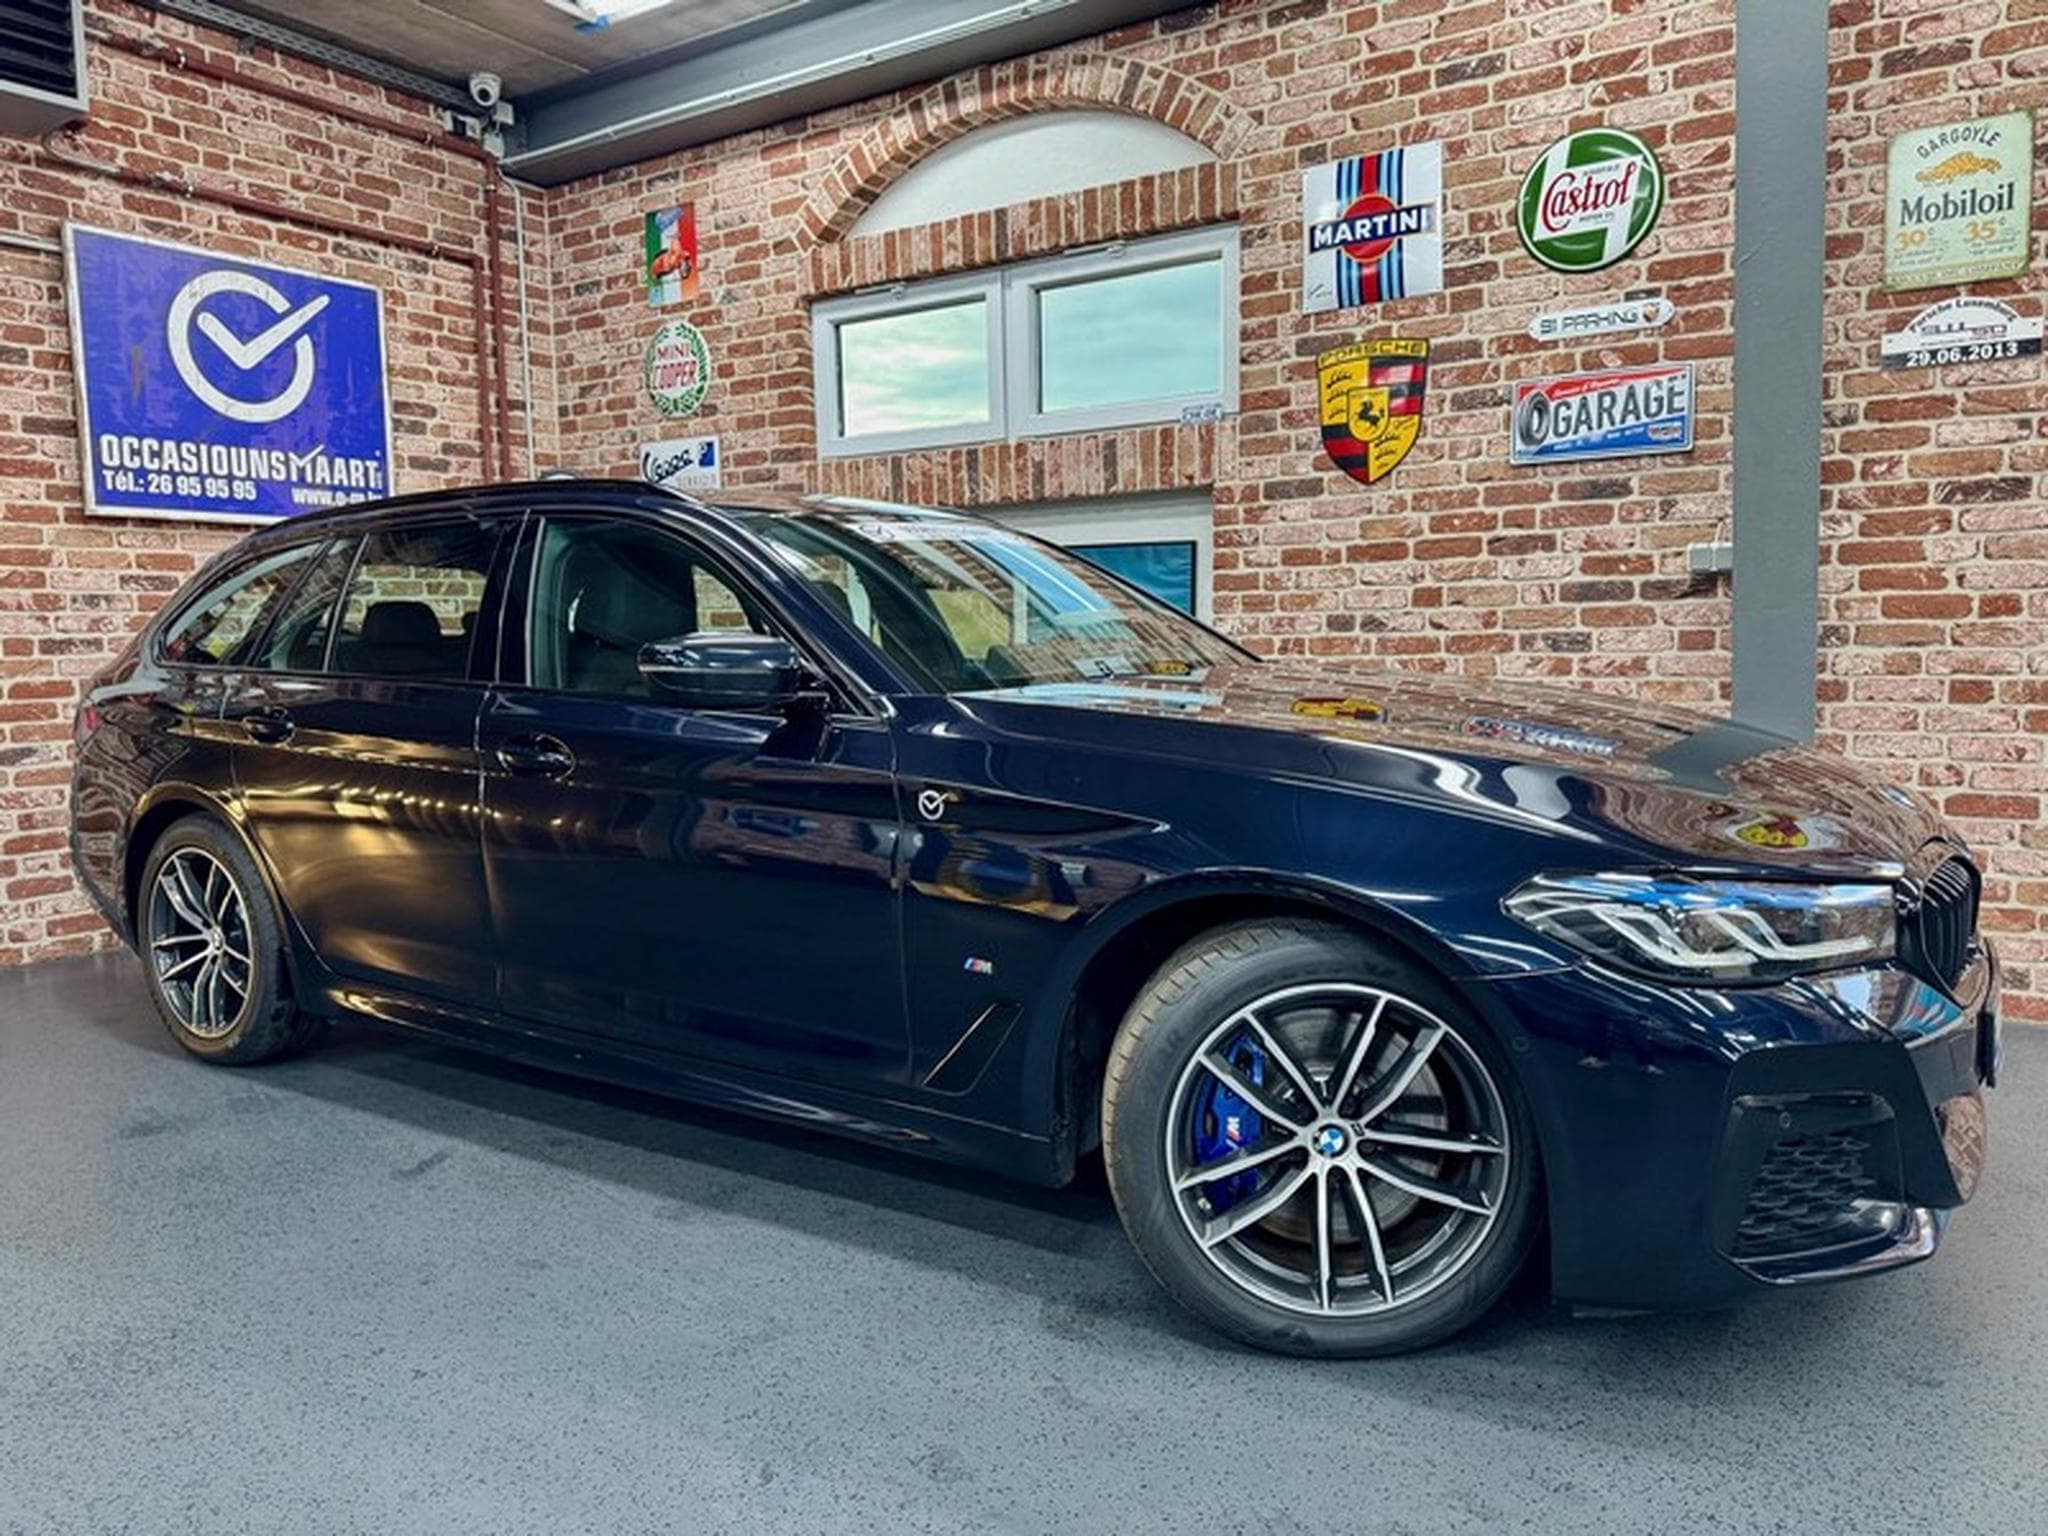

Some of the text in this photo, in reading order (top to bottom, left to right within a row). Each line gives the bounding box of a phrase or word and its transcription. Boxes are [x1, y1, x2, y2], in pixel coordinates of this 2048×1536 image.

[1916, 126, 2001, 159] GARGOYLE
[1542, 161, 1636, 233] Castrol
[1900, 181, 2014, 226] Mobiloil
[1314, 207, 1427, 249] MARTINI
[1562, 311, 1638, 331] PARKING
[1906, 342, 2018, 367] 29.06.2013
[1552, 373, 1687, 438] GARAGE
[148, 473, 173, 495] 26
[176, 475, 201, 497] 95
[205, 478, 230, 498] 95
[232, 481, 257, 501] 95
